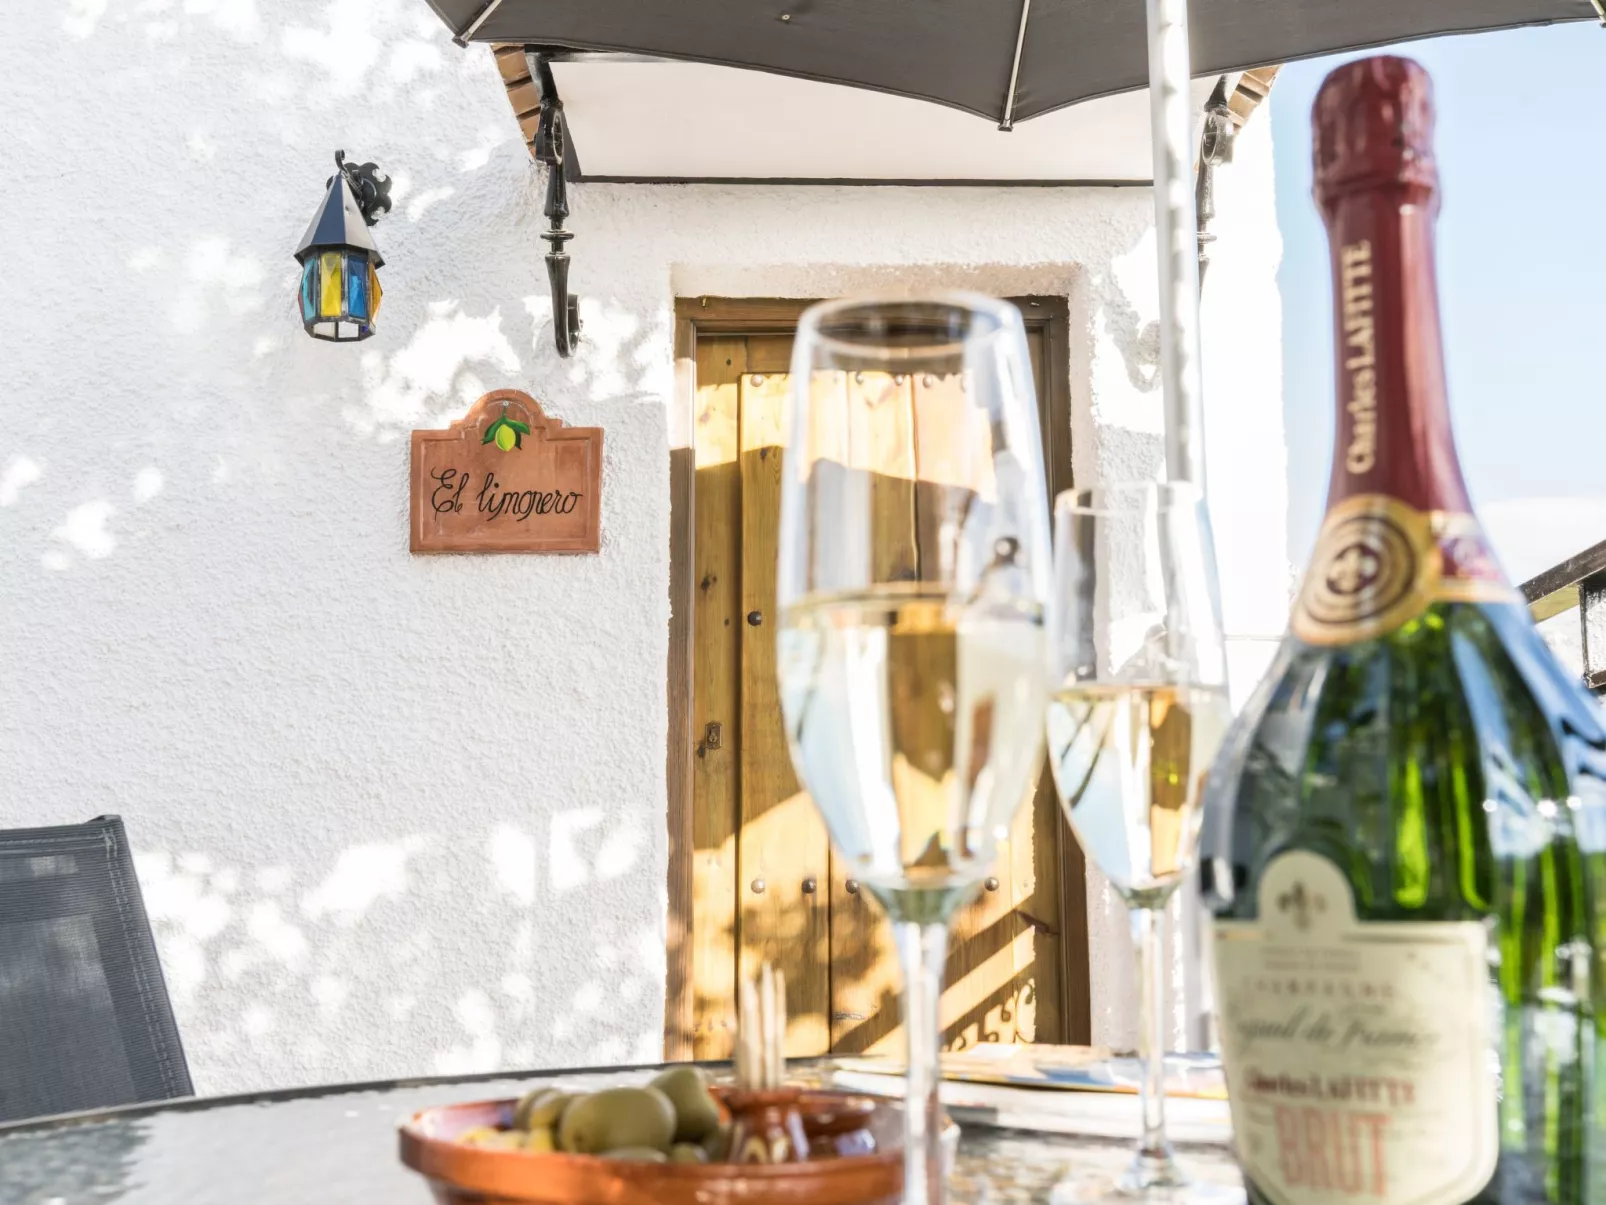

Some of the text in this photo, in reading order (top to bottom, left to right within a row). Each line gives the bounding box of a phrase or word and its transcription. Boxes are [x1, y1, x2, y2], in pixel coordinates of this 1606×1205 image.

[430, 466, 584, 522] El limonero
[1273, 1105, 1392, 1197] BRUT
